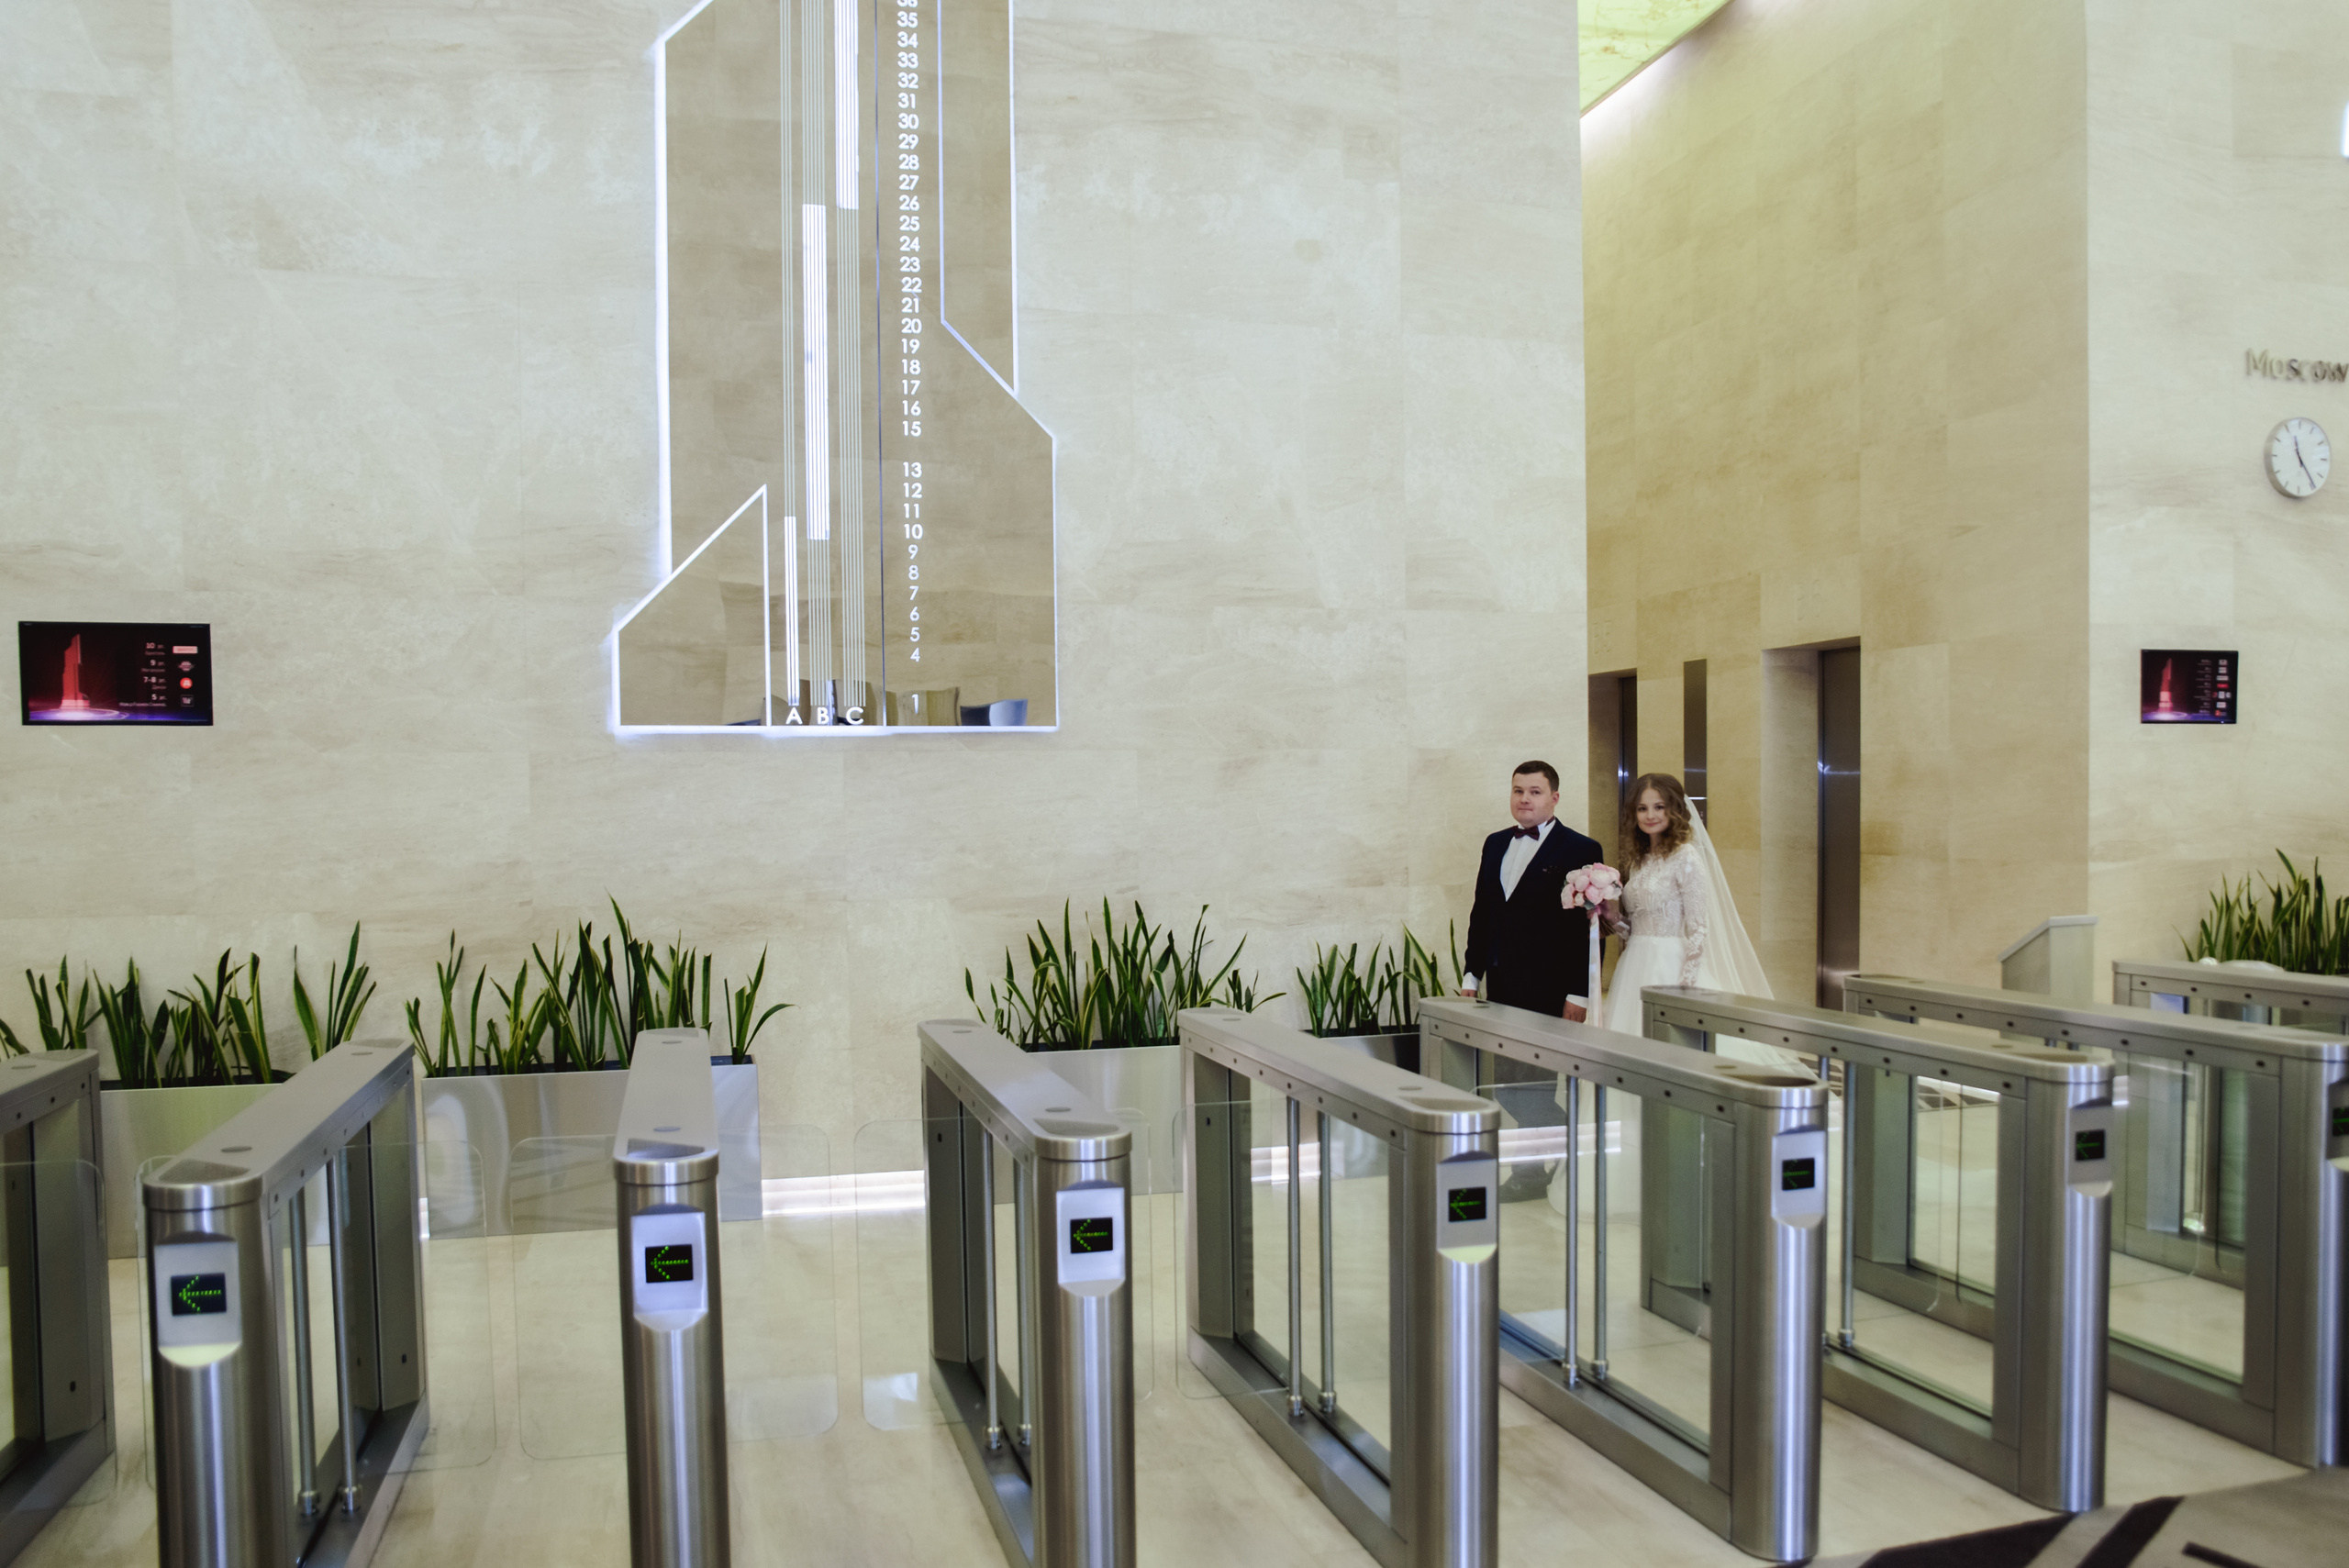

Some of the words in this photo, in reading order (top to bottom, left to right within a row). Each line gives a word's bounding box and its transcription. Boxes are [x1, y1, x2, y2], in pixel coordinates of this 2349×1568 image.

[897, 11, 918, 28] 35
[897, 31, 918, 48] 34
[897, 51, 918, 68] 33
[897, 72, 918, 88] 32
[898, 93, 916, 108] 31
[898, 113, 918, 129] 30
[898, 133, 918, 149] 29
[898, 153, 919, 170] 28
[899, 174, 919, 190] 27
[899, 195, 919, 211] 26
[899, 216, 920, 231] 25
[900, 236, 920, 251] 24
[900, 256, 920, 272] 23
[901, 277, 921, 293] 22
[902, 297, 919, 313] 21
[902, 317, 922, 334] 20
[902, 339, 920, 354] 19
[902, 359, 921, 374] 18
[902, 379, 921, 395] 17
[902, 400, 921, 416] 16
[902, 421, 922, 436] 15
[903, 462, 922, 477] 13
[904, 483, 922, 498] 12
[904, 503, 919, 519] 11
[904, 524, 923, 539] 10
[908, 544, 918, 560] 9
[908, 564, 918, 581] 8
[909, 585, 919, 601] 7
[910, 606, 919, 621] 6
[910, 627, 919, 641] 5
[910, 647, 920, 662] 4
[911, 694, 919, 714] 1
[785, 706, 803, 724] A
[818, 706, 829, 724] B
[846, 706, 863, 725] C
